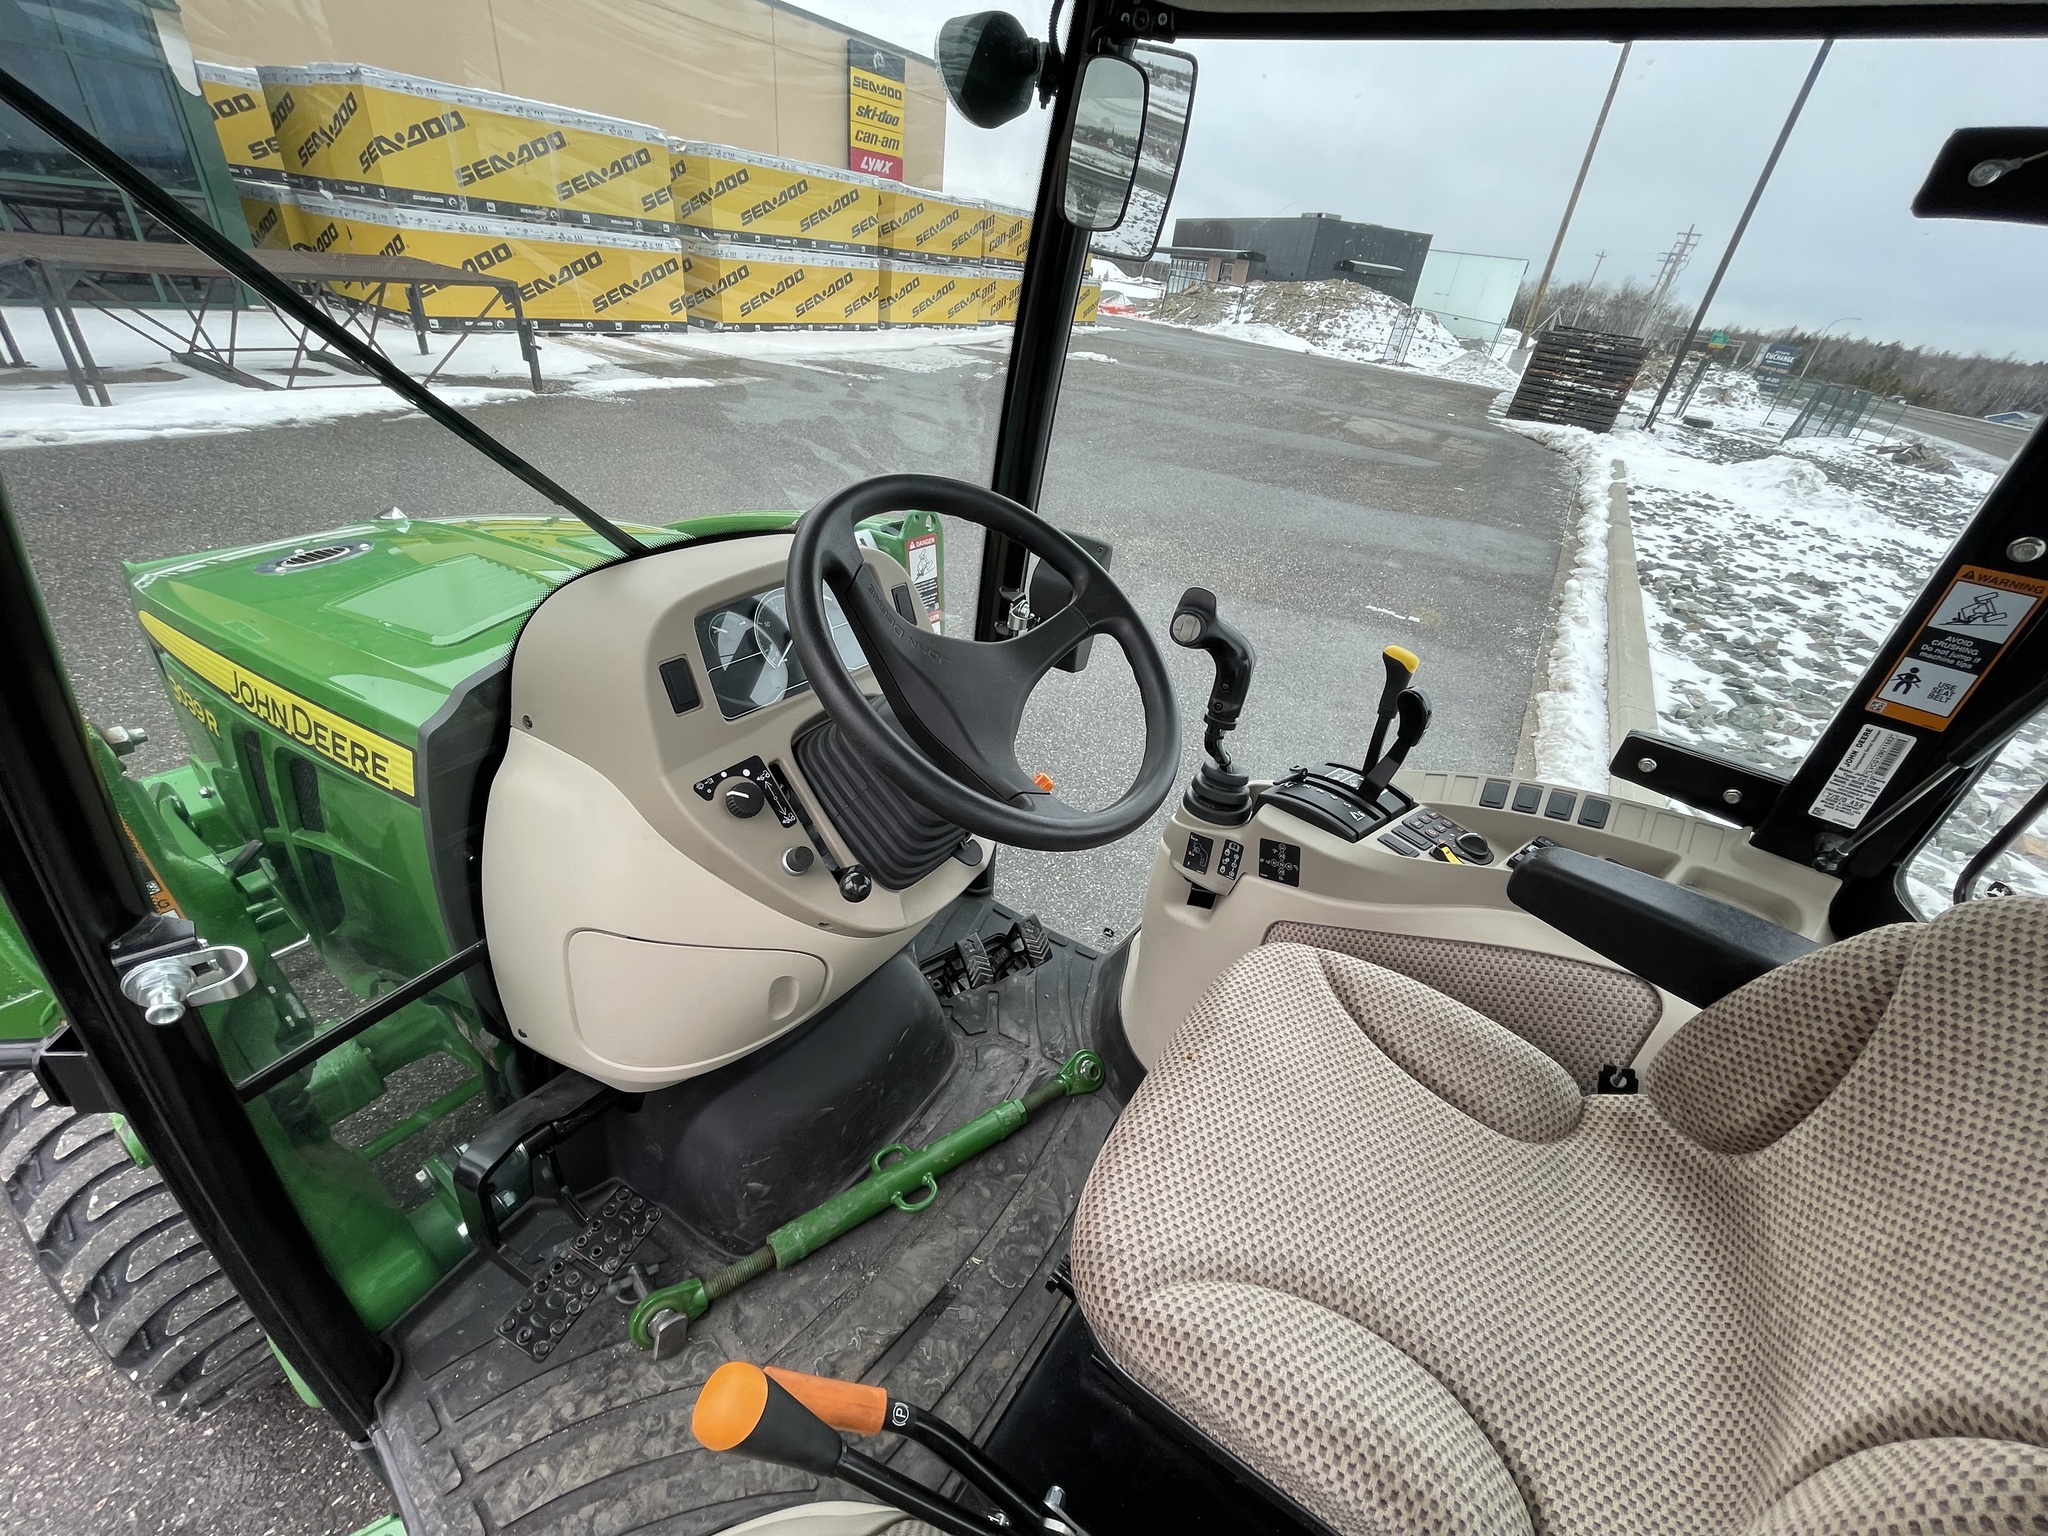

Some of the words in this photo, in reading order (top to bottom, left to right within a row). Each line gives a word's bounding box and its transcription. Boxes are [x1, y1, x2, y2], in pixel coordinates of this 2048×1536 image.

[855, 104, 900, 127] ski-doo
[855, 129, 900, 151] can-am
[860, 156, 894, 174] LYNX
[915, 537, 935, 548] DANGER
[1978, 573, 2046, 594] WARNING
[1931, 639, 1979, 656] CRUSHING
[1944, 635, 1974, 647] AVOID
[1919, 651, 1955, 665] machine
[1956, 660, 1973, 669] tips
[1921, 644, 1934, 652] Do
[1934, 648, 1950, 656] not
[1949, 651, 1972, 662] jump
[1931, 687, 1956, 698] SEAT
[1937, 681, 1958, 692] USE
[1926, 692, 1951, 704] BELT
[229, 670, 288, 731] JOHN
[291, 703, 391, 785] DEERE
[1844, 749, 1859, 767] JOHN
[1856, 727, 1874, 748] DEERE
